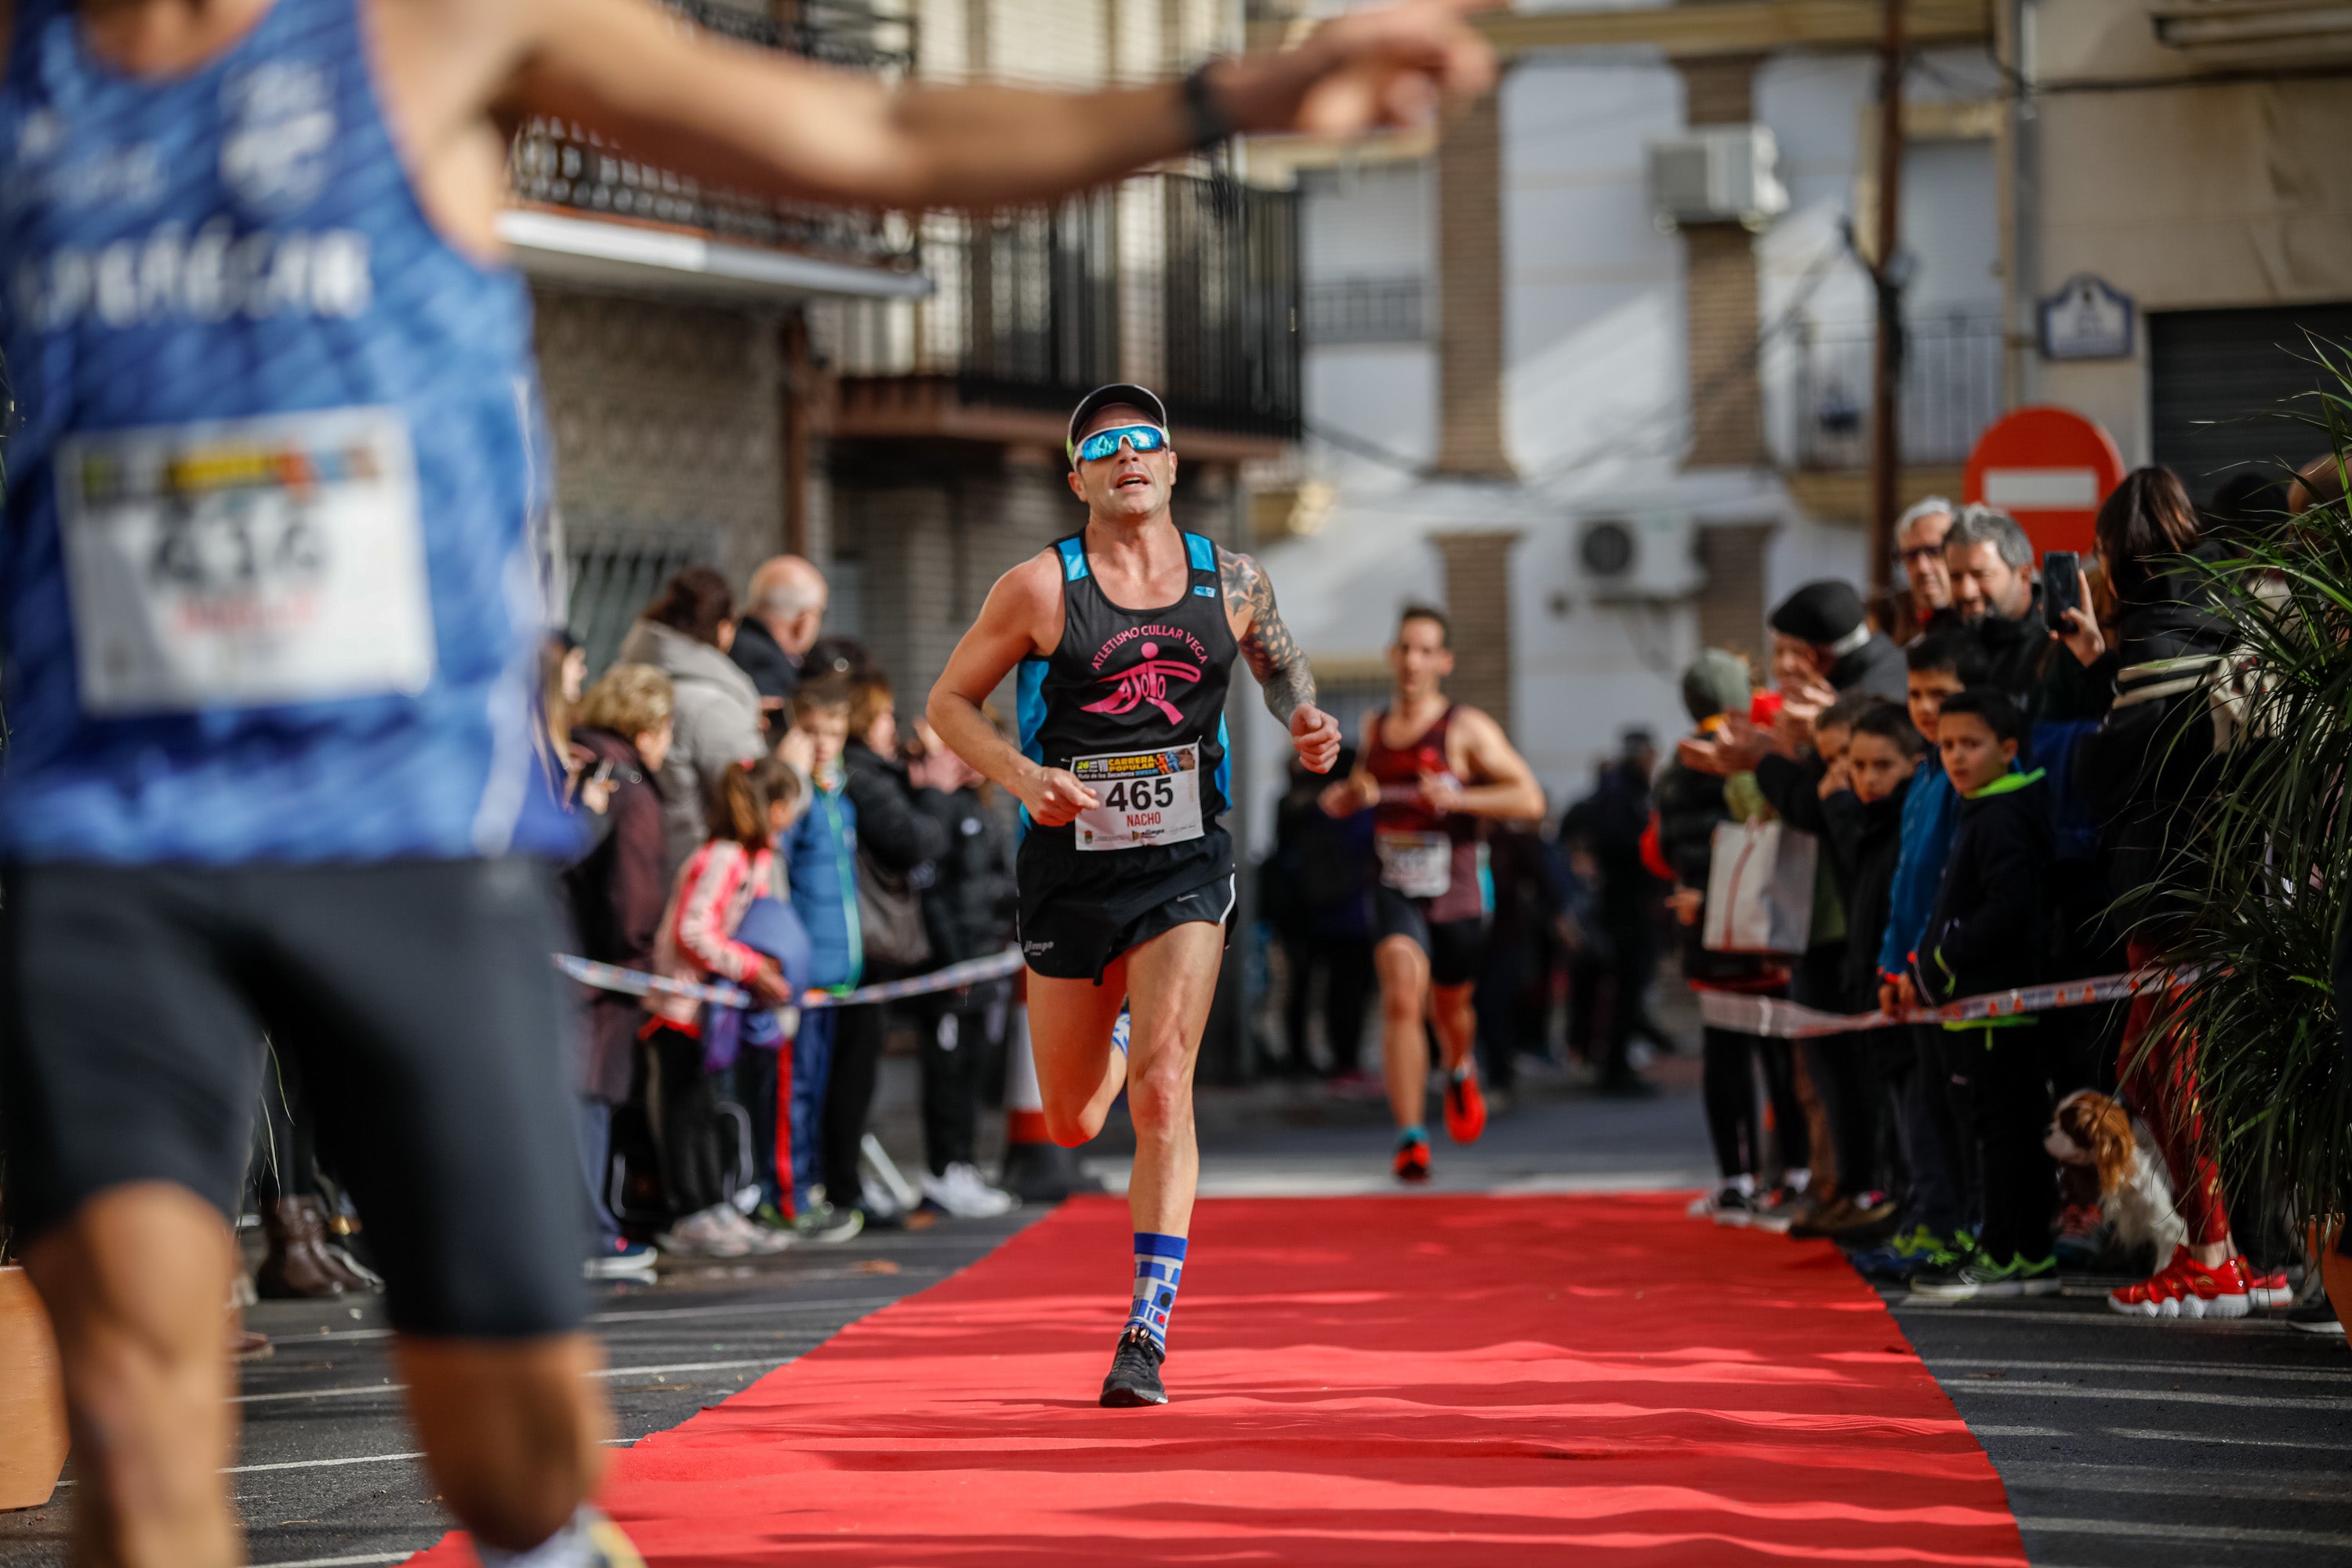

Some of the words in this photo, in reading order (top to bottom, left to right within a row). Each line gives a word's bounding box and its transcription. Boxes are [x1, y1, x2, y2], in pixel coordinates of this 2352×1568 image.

[1091, 626, 1140, 671] ATLETISMO
[1141, 625, 1184, 640] CULLAR
[1185, 632, 1208, 664] VEGA
[1108, 754, 1155, 766] CARRERA
[1109, 762, 1155, 772] POPULAR
[1105, 777, 1174, 812] 465
[1127, 811, 1161, 827] NACHO
